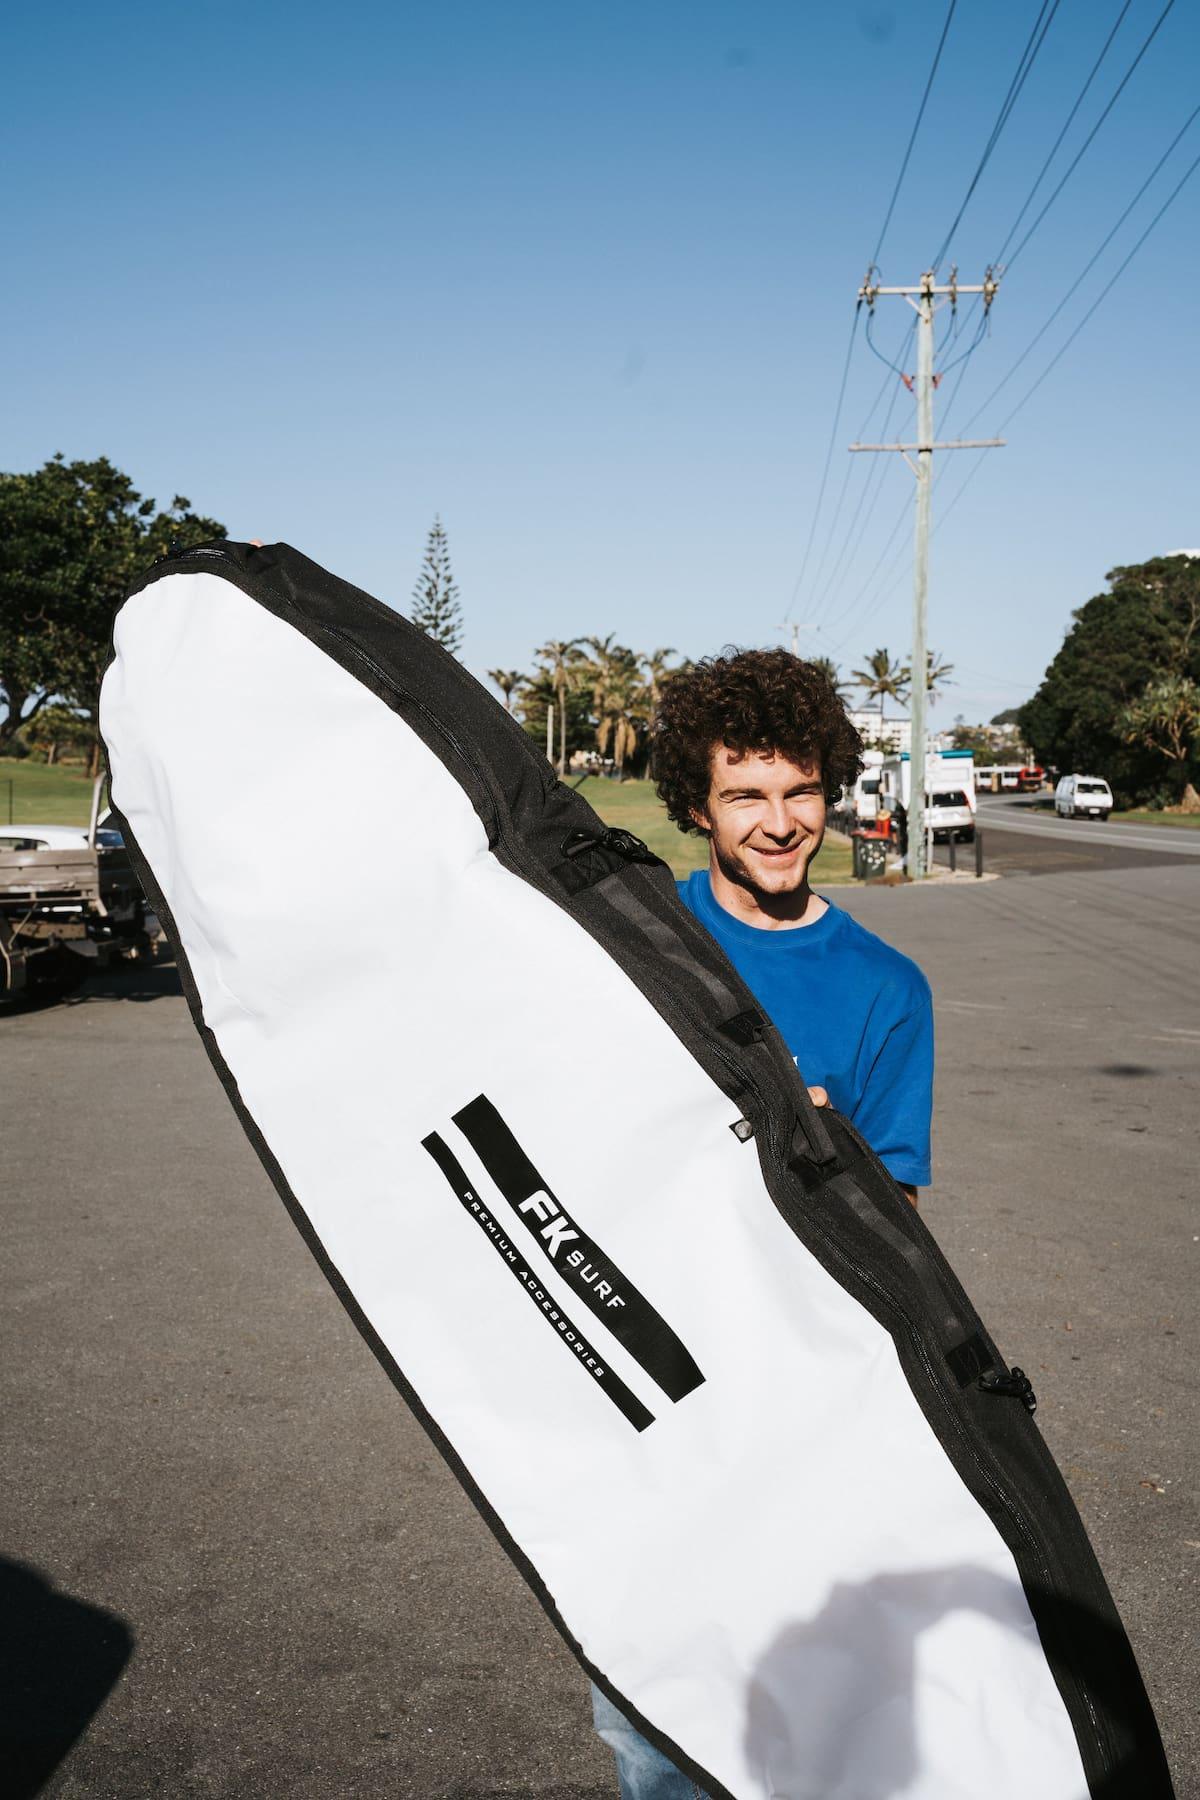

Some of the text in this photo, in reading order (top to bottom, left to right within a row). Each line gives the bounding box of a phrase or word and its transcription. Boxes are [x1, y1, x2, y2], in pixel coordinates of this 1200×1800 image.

[463, 1191, 605, 1378] PREMIUM ACCESSORIES
[518, 1189, 626, 1311] FK SURF
